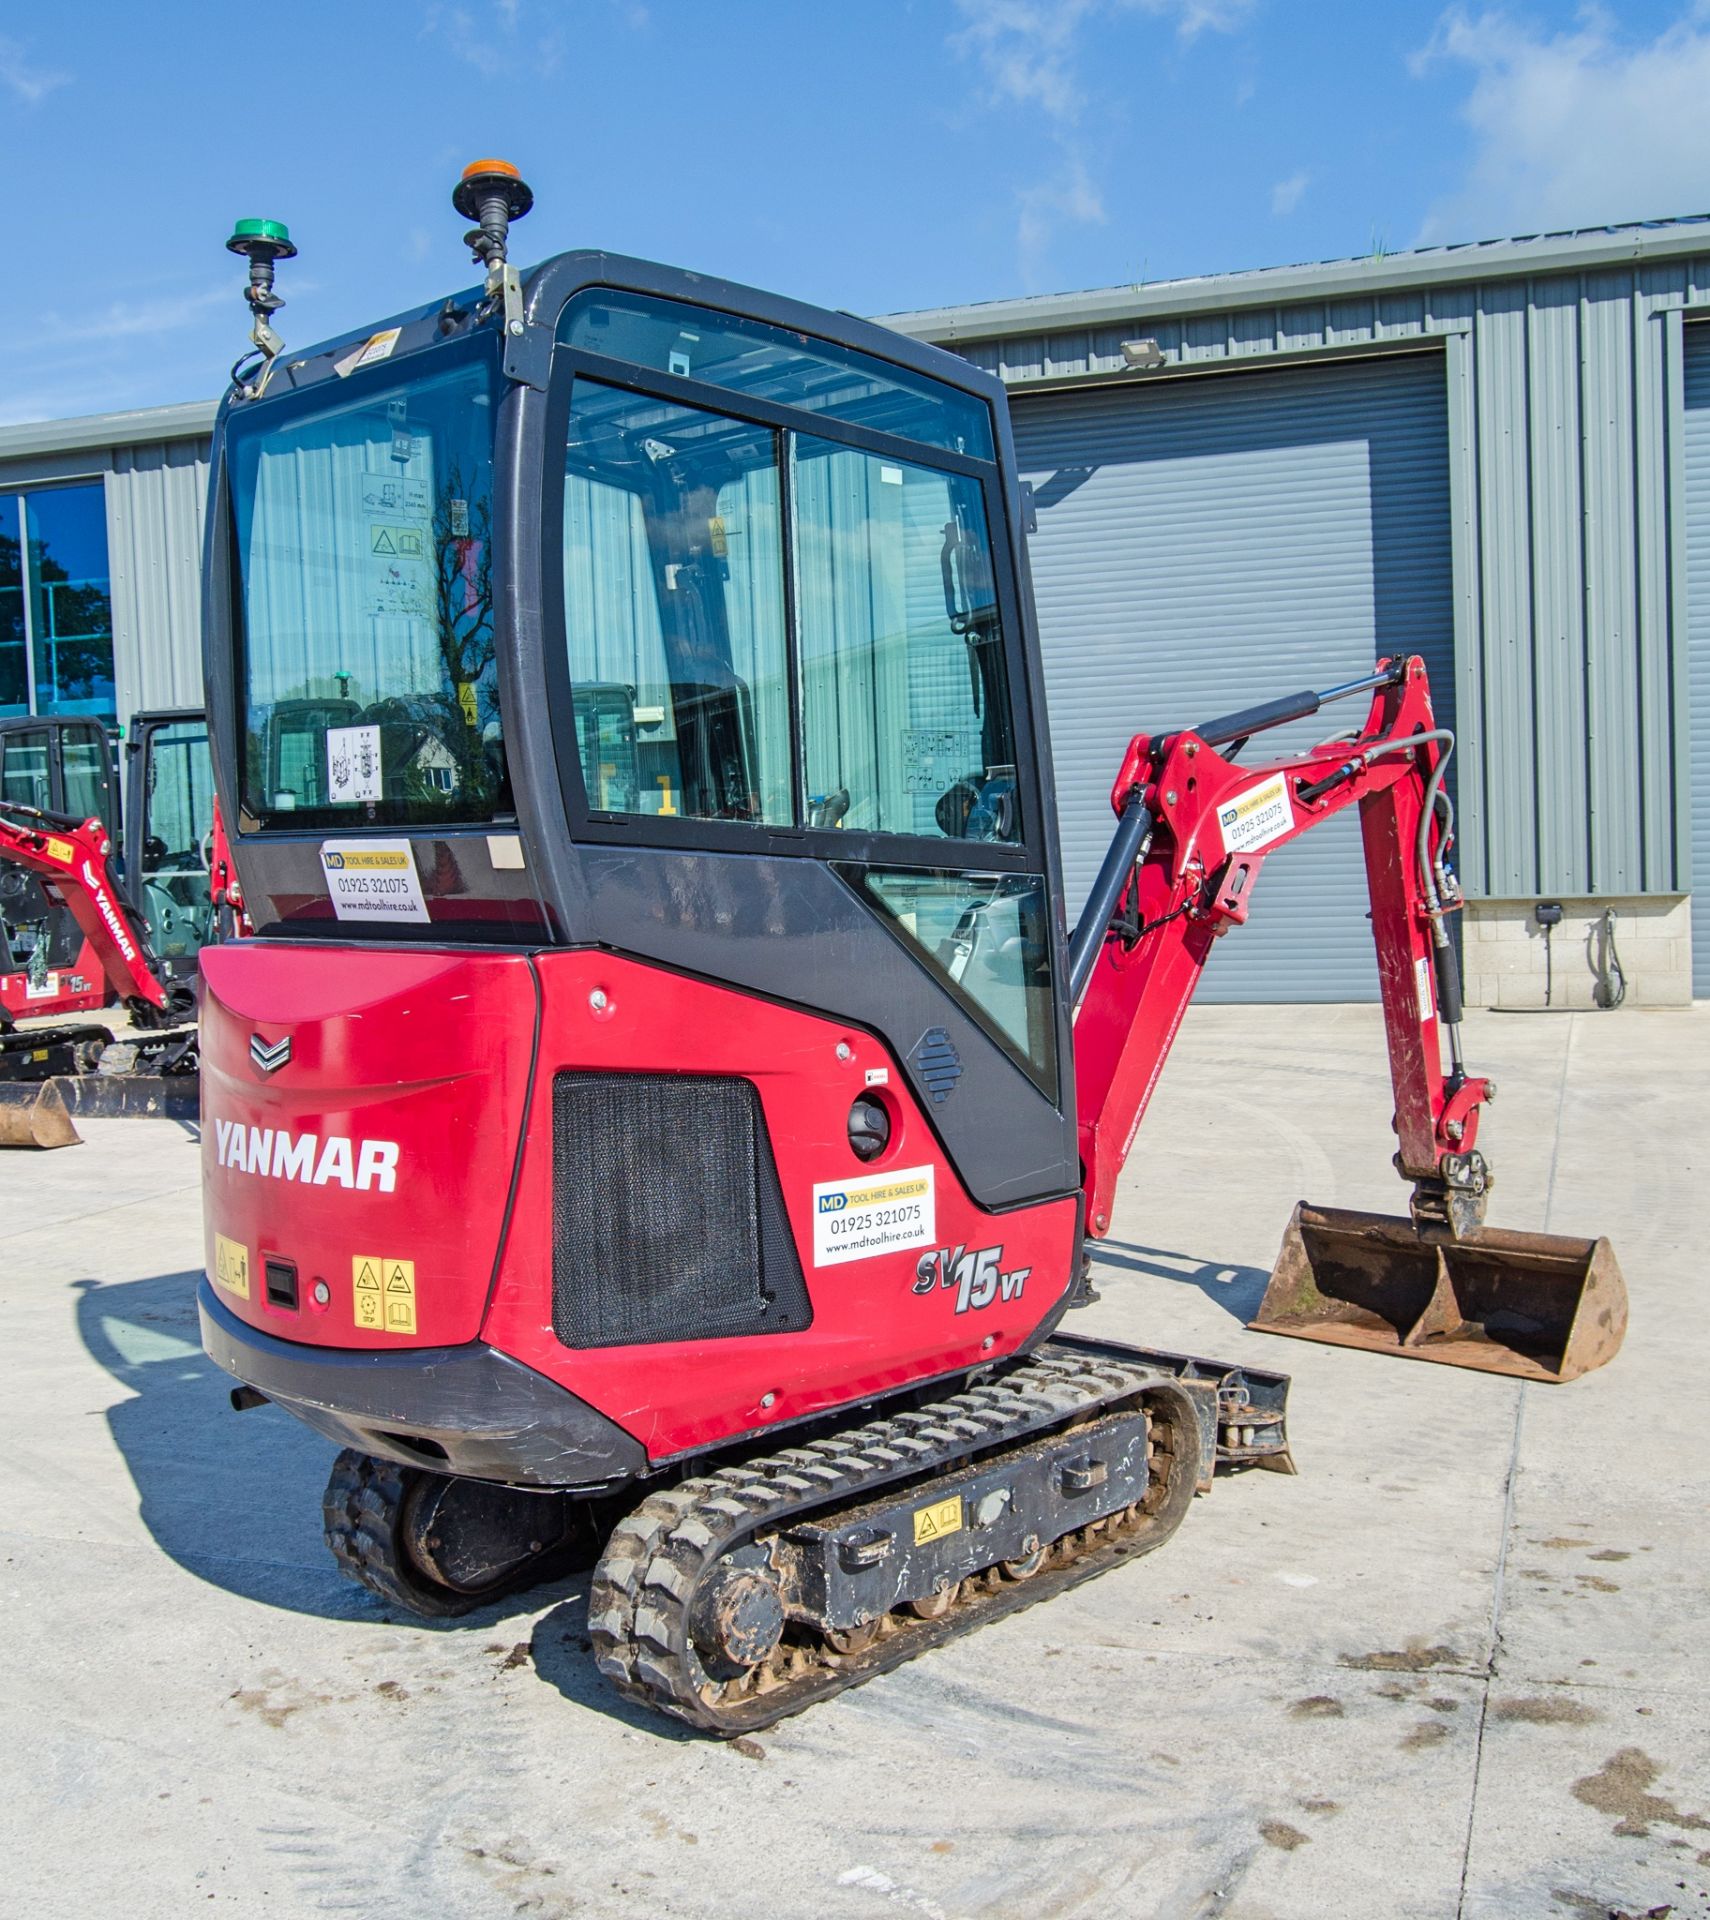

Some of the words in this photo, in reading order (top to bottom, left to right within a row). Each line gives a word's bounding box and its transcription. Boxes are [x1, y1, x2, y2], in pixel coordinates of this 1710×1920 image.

[1231, 818, 1255, 840] 01925
[1255, 802, 1283, 826] 321075
[325, 854, 343, 868] MD
[345, 856, 360, 865] TOOL
[361, 856, 375, 865] HIRE
[380, 856, 398, 865] SALES
[398, 856, 407, 865] UK
[338, 878, 369, 893] 01925
[371, 878, 409, 893] 321075
[341, 898, 418, 912] www.mdtoolhire.co.uk
[95, 888, 136, 961] YANMAR
[214, 1118, 399, 1193] YANMAR
[821, 1197, 844, 1212] MD
[850, 1194, 870, 1204] TOOL
[871, 1190, 886, 1201] HIRE
[894, 1184, 915, 1196] SALES
[915, 1182, 926, 1192] UK
[830, 1214, 872, 1235] 01925
[875, 1204, 921, 1227] 321075
[826, 1224, 925, 1254] www.mdtoolhire.co.uk
